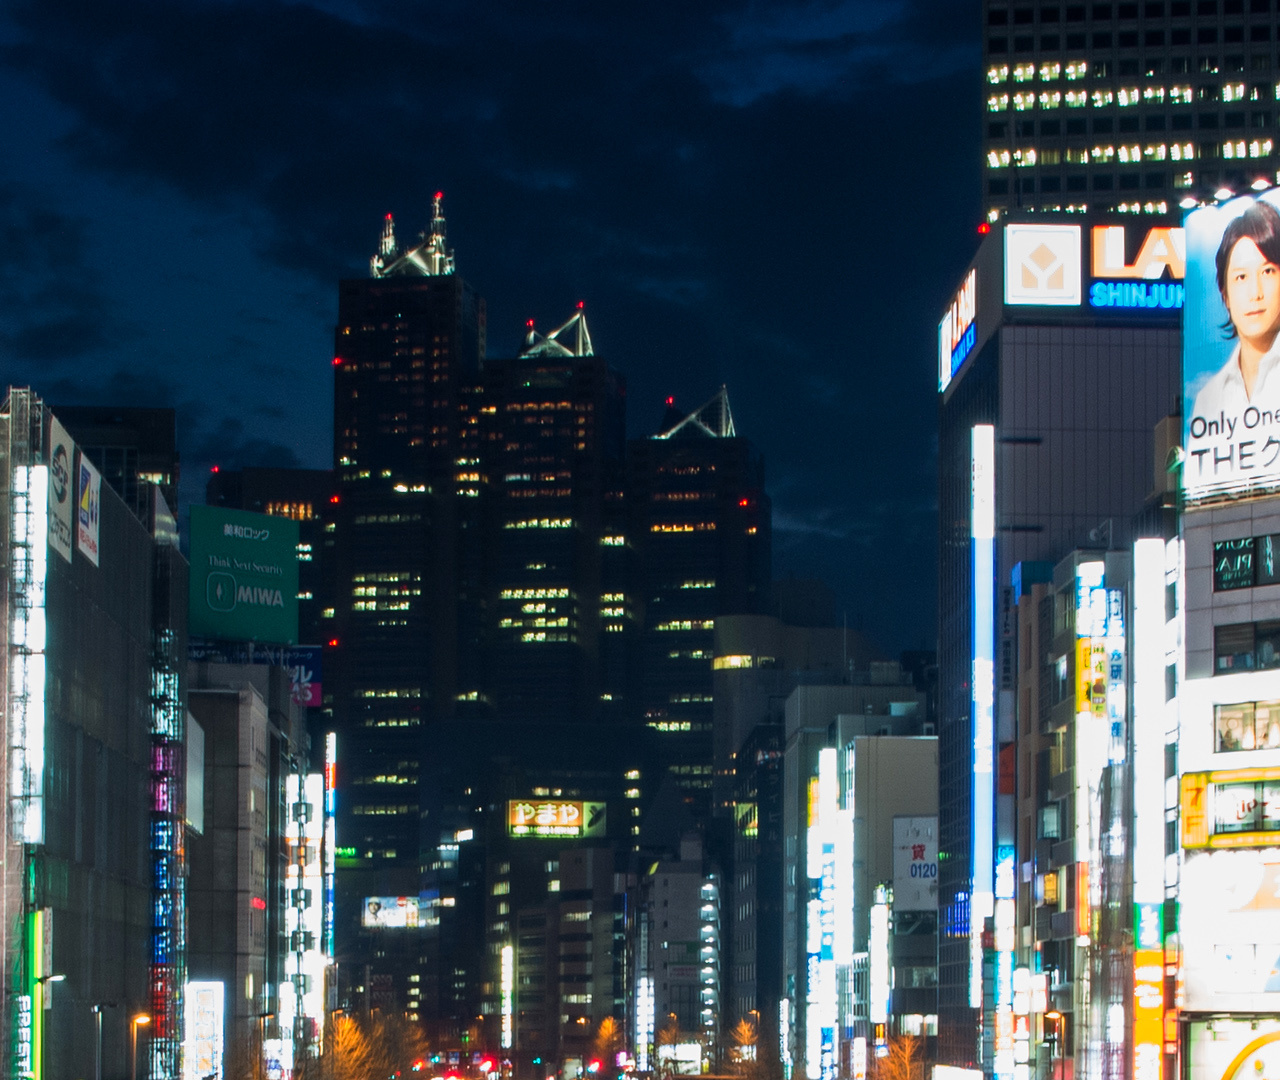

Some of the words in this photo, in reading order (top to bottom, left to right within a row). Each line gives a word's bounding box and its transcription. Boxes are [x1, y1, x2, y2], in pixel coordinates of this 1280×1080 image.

[1190, 413, 1240, 443] Only
[223, 523, 270, 541] 美和ロック
[208, 556, 232, 570] Think
[233, 558, 251, 573] Next
[252, 560, 284, 576] Security
[238, 585, 285, 607] MIWA
[513, 802, 581, 826] やまや
[910, 863, 938, 879] 0120
